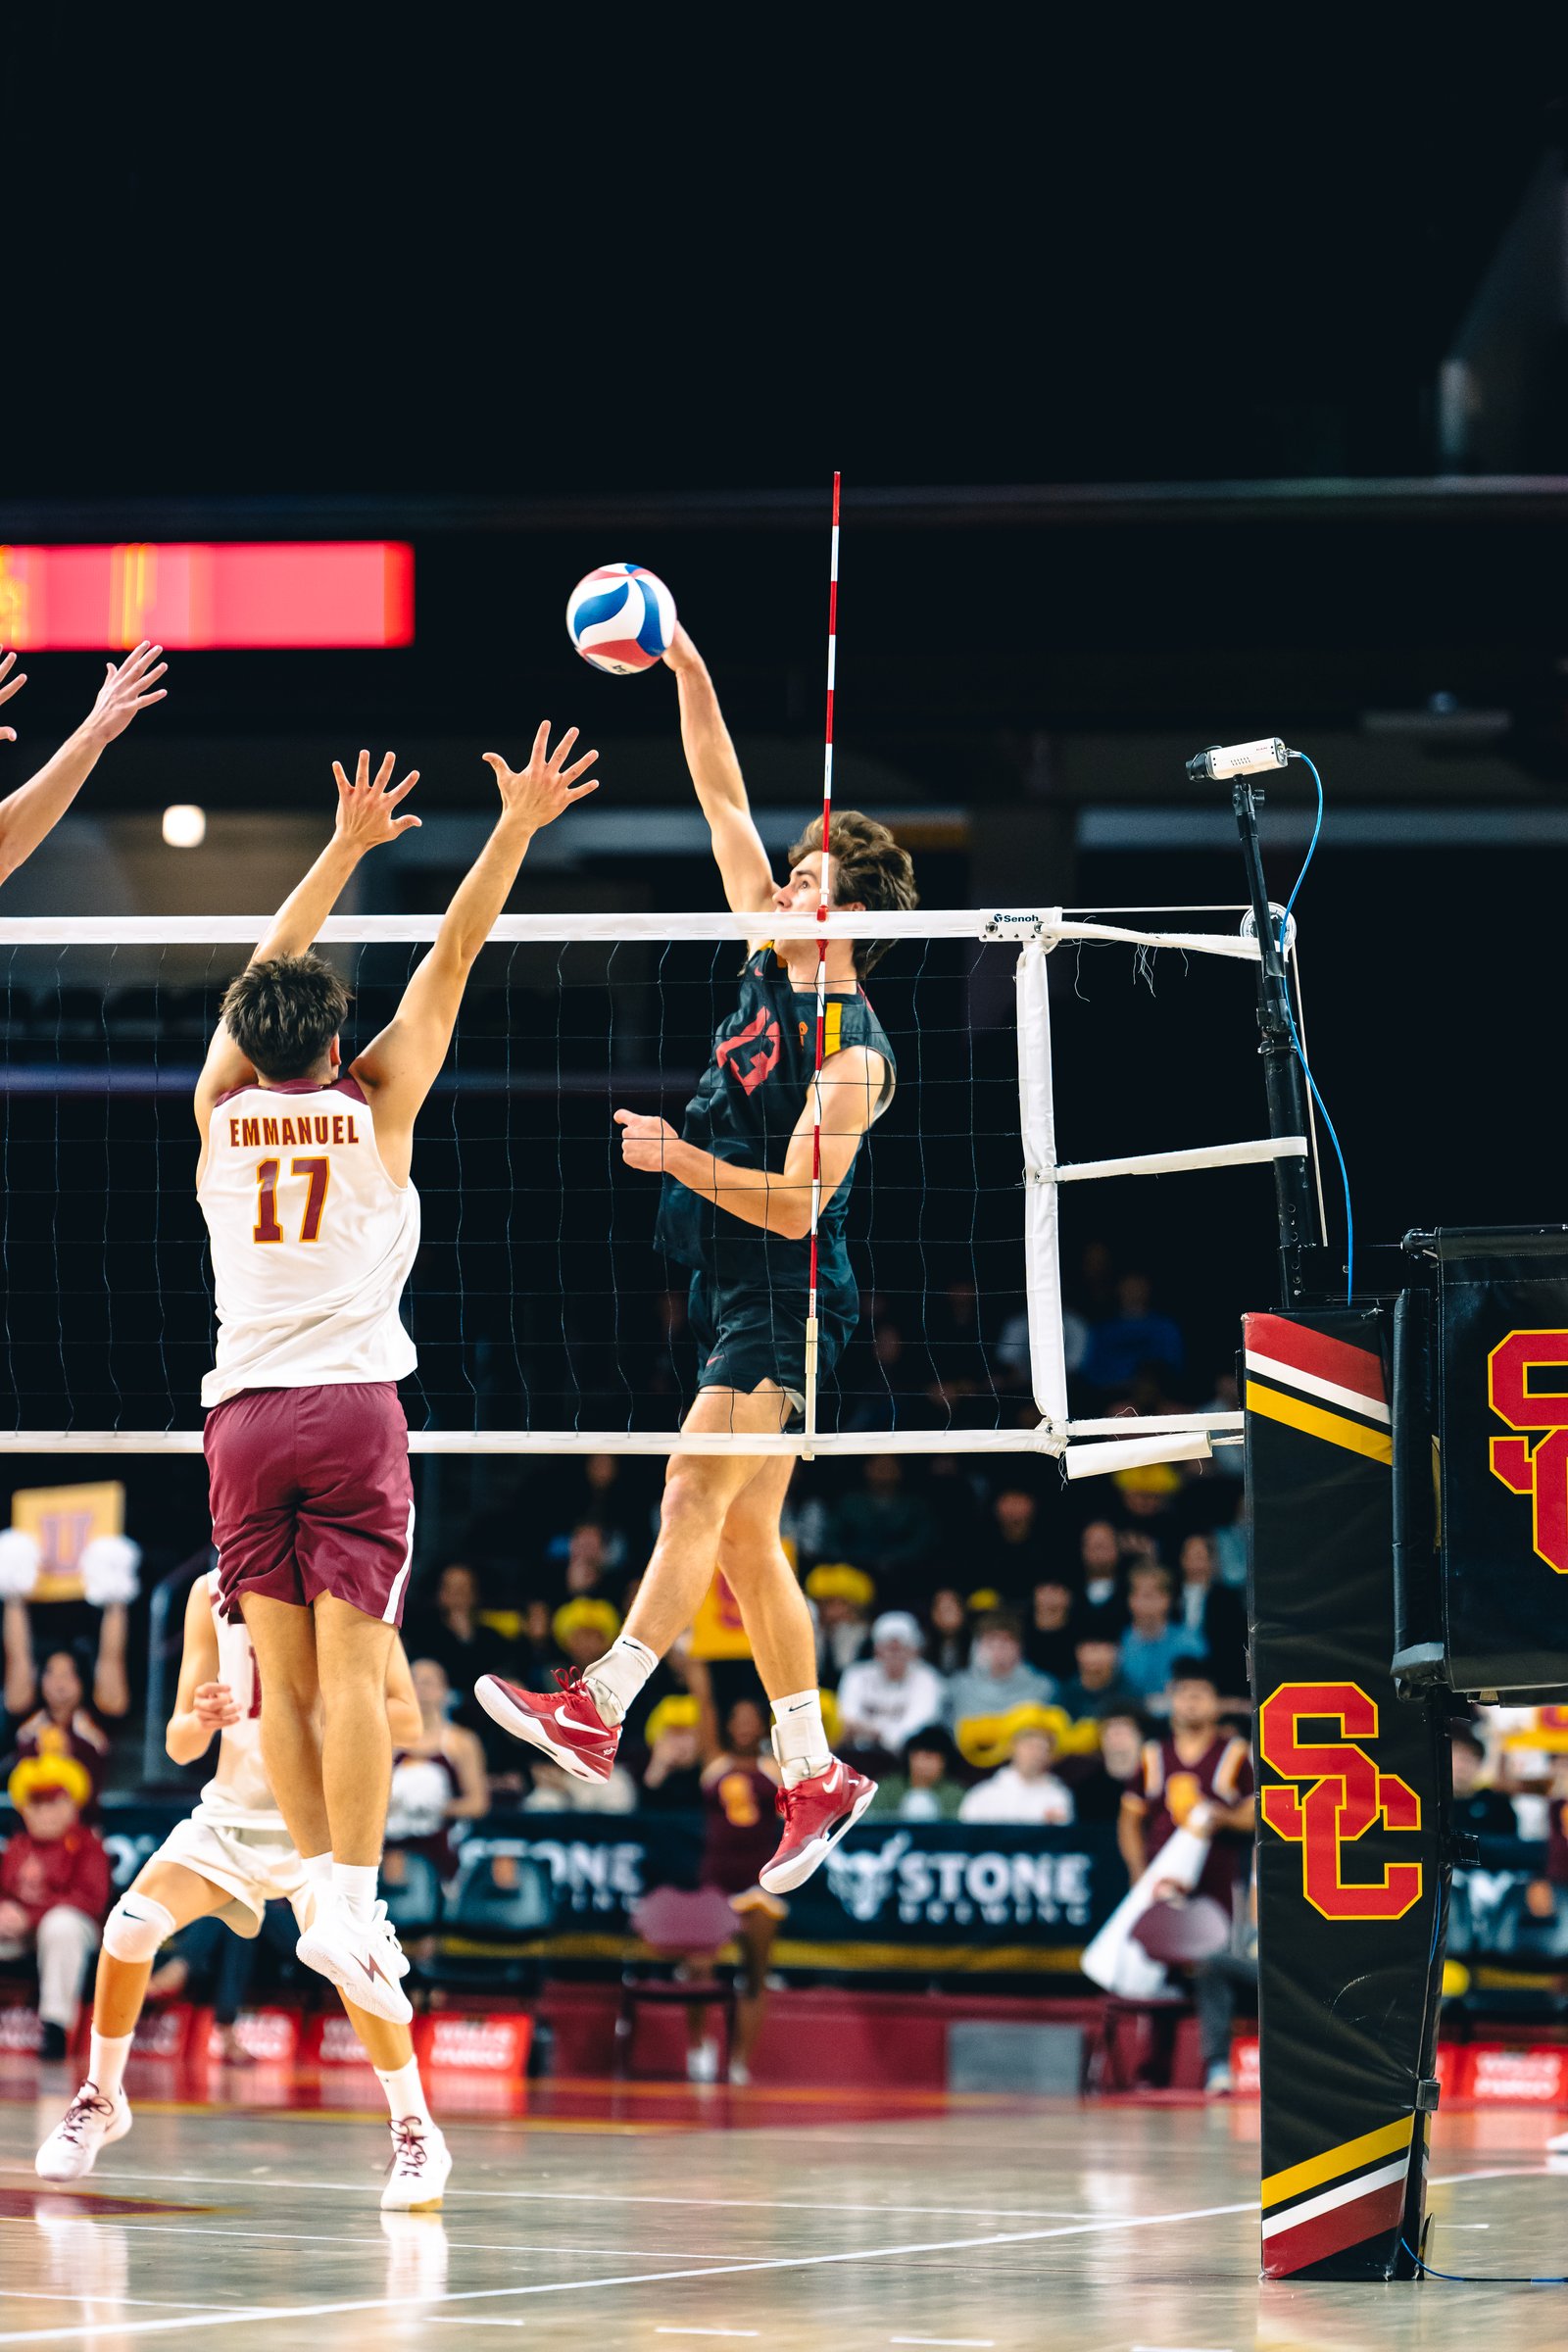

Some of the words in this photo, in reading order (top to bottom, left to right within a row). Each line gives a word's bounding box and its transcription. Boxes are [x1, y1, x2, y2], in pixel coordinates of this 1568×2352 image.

[229, 1115, 360, 1147] EMMANUEL
[253, 1156, 330, 1244] 17
[1259, 1682, 1422, 1921] SC
[898, 1851, 1090, 1904] STONE
